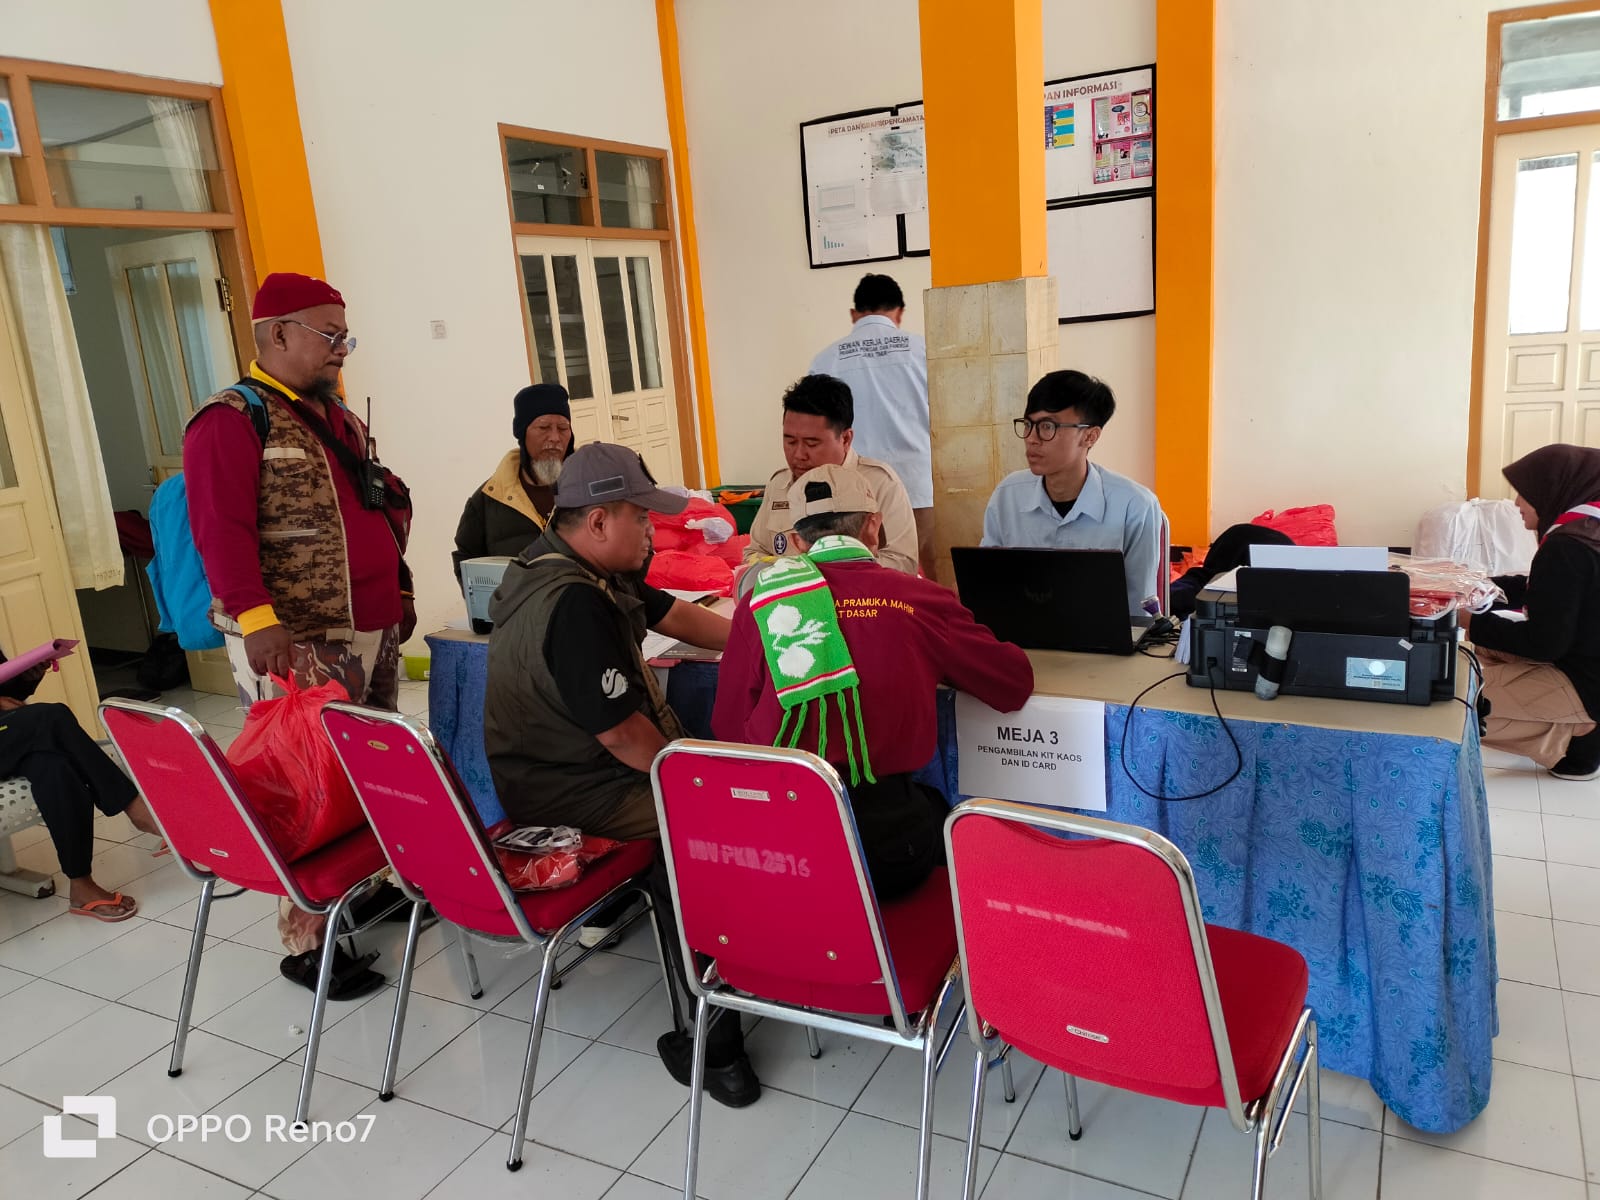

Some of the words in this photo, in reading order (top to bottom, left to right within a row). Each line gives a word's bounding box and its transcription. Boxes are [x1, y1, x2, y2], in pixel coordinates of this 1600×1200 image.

[1044, 91, 1060, 100] AN
[1063, 81, 1118, 97] INFORMASI
[830, 125, 846, 134] PETA
[847, 123, 860, 131] DAN
[885, 115, 924, 125] PENGAMATA
[839, 340, 861, 351] DEWAN
[862, 338, 883, 347] KERJA
[884, 335, 909, 344] DAERAH
[843, 597, 887, 608] PRAMUKA
[846, 608, 878, 618] DASAR
[997, 726, 1045, 744] MEJA
[1049, 730, 1059, 745] 3
[977, 745, 1038, 758] PENGAMBILAN
[1040, 751, 1055, 760] KIT
[1056, 752, 1082, 763] KAOS
[1001, 758, 1019, 767] DAN
[1021, 760, 1030, 768] ID
[1032, 761, 1057, 771] CARD
